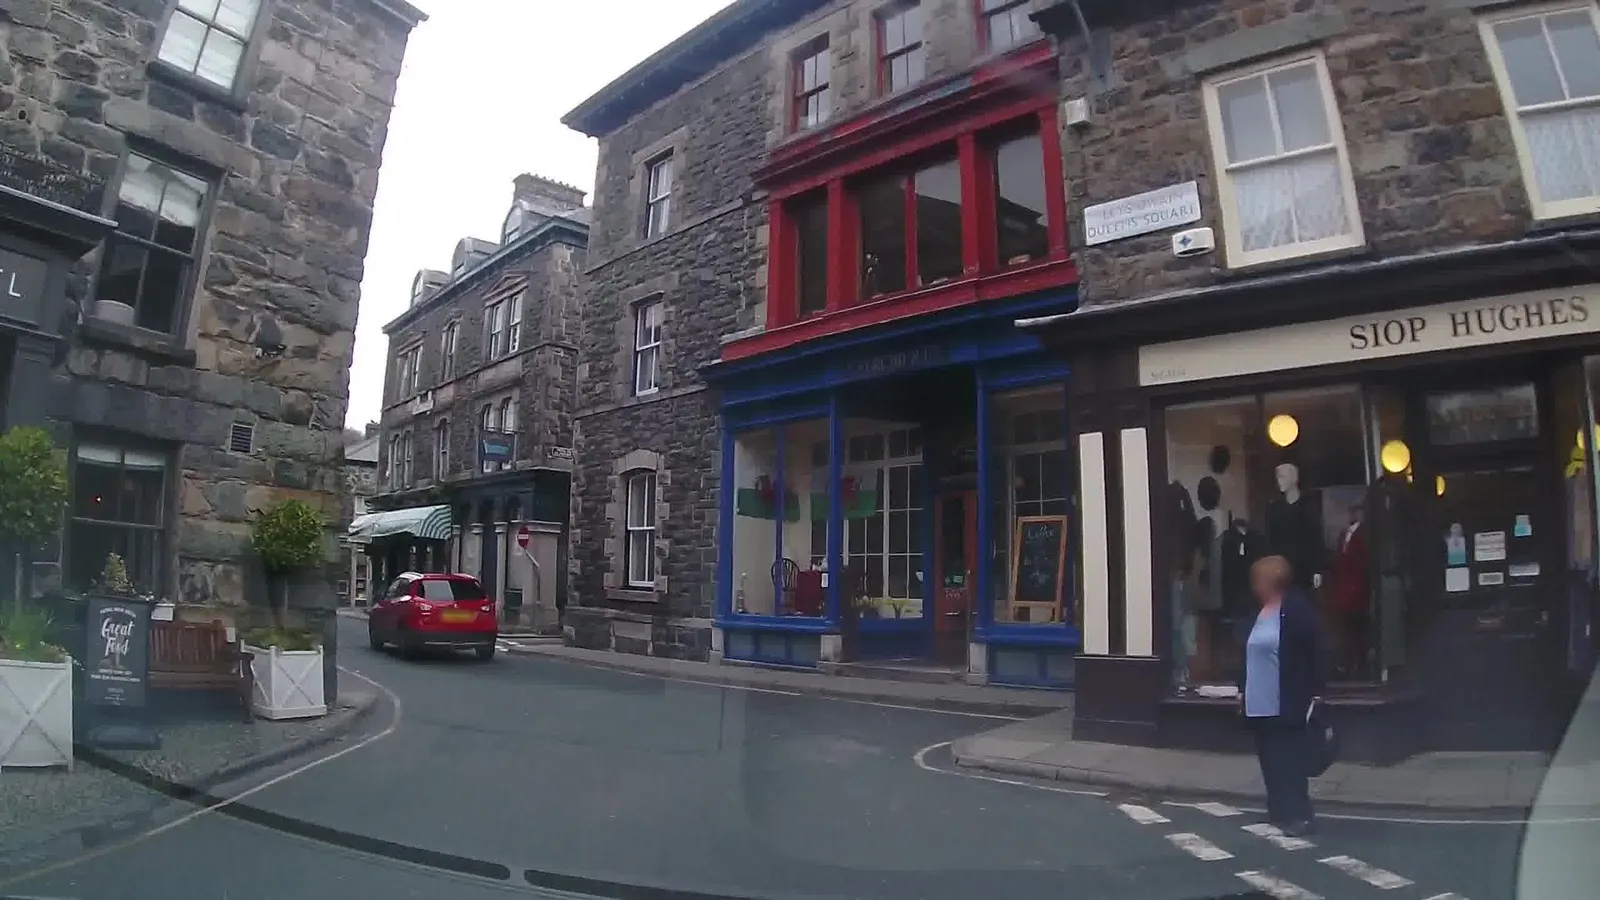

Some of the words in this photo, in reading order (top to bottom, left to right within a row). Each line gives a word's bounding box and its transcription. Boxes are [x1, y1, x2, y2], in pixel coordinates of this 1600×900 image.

[1350, 316, 1426, 350] SIOP
[1450, 295, 1589, 338] HUGHES
[101, 617, 135, 638] Great
[105, 637, 130, 656] Food
